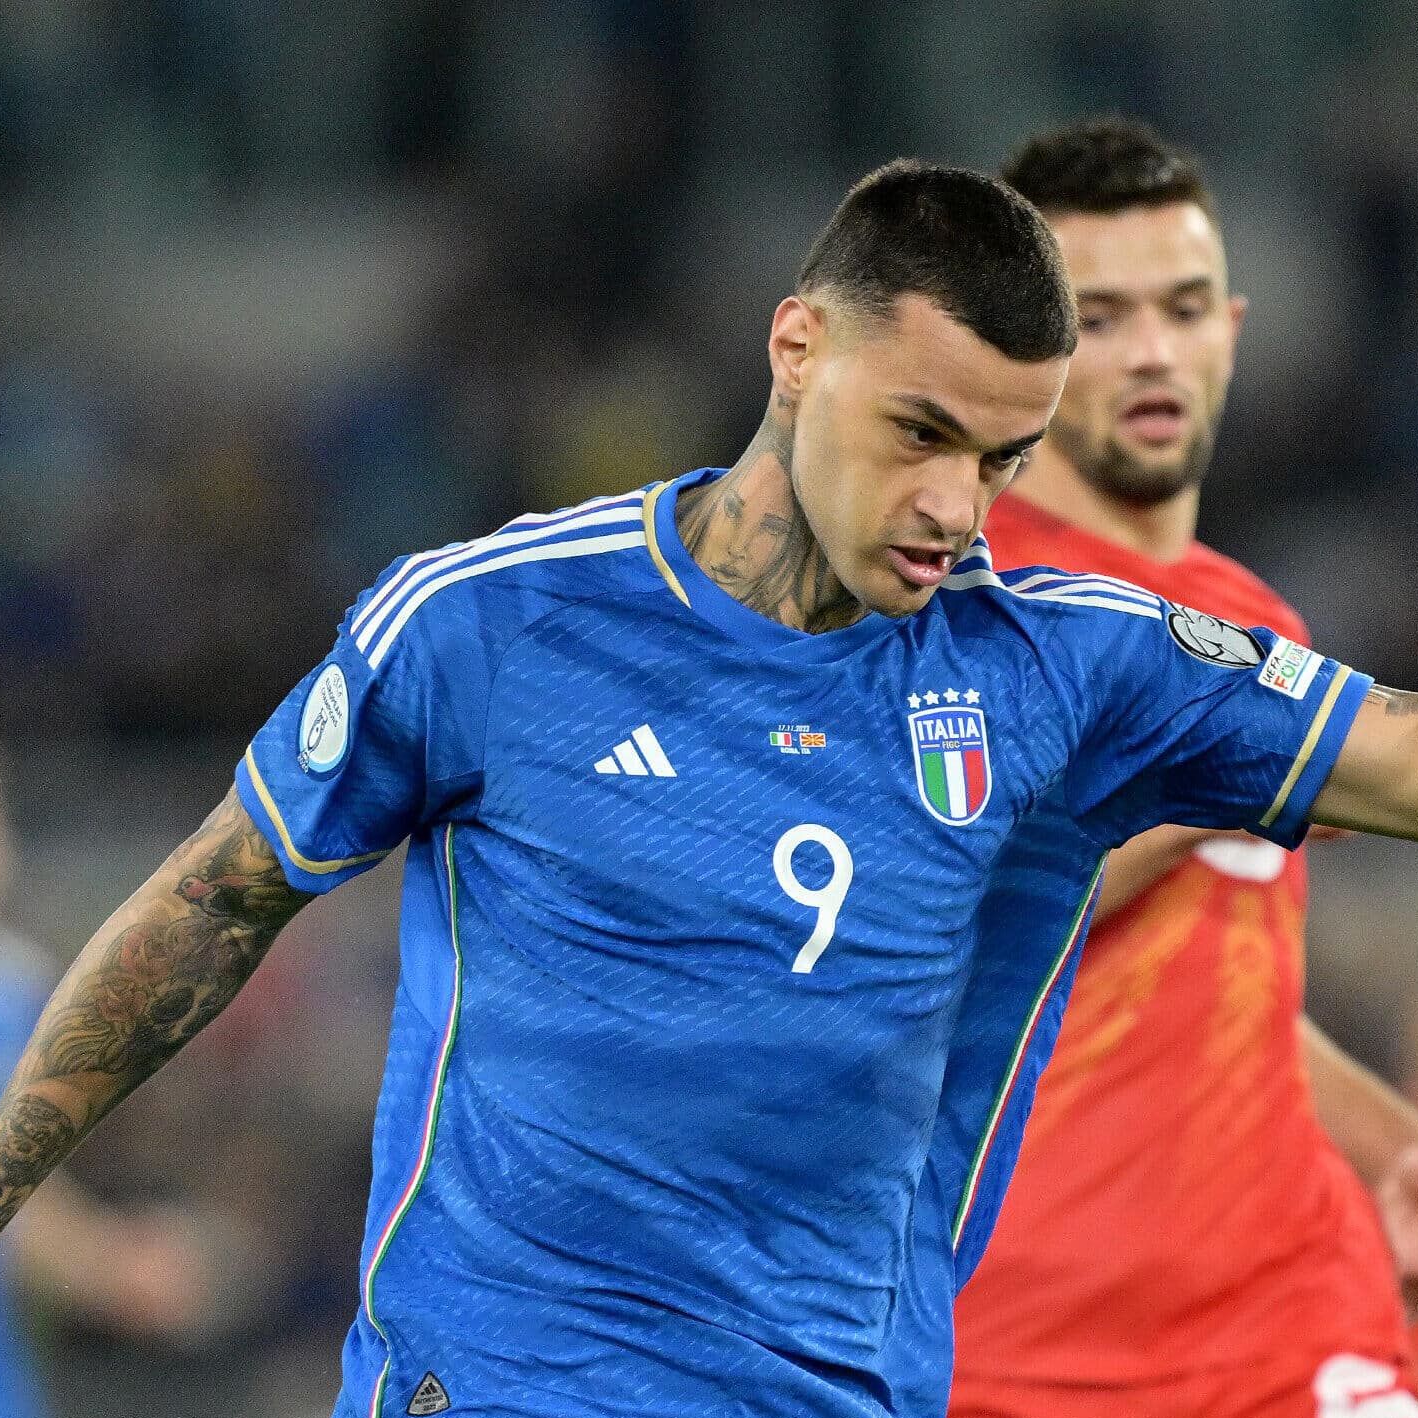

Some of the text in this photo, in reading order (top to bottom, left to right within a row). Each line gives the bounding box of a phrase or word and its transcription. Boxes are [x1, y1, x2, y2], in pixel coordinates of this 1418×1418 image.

[1263, 656, 1281, 683] UEFA
[916, 716, 981, 742] ITALIA
[942, 740, 961, 749] FIGC
[773, 823, 854, 974] 9
